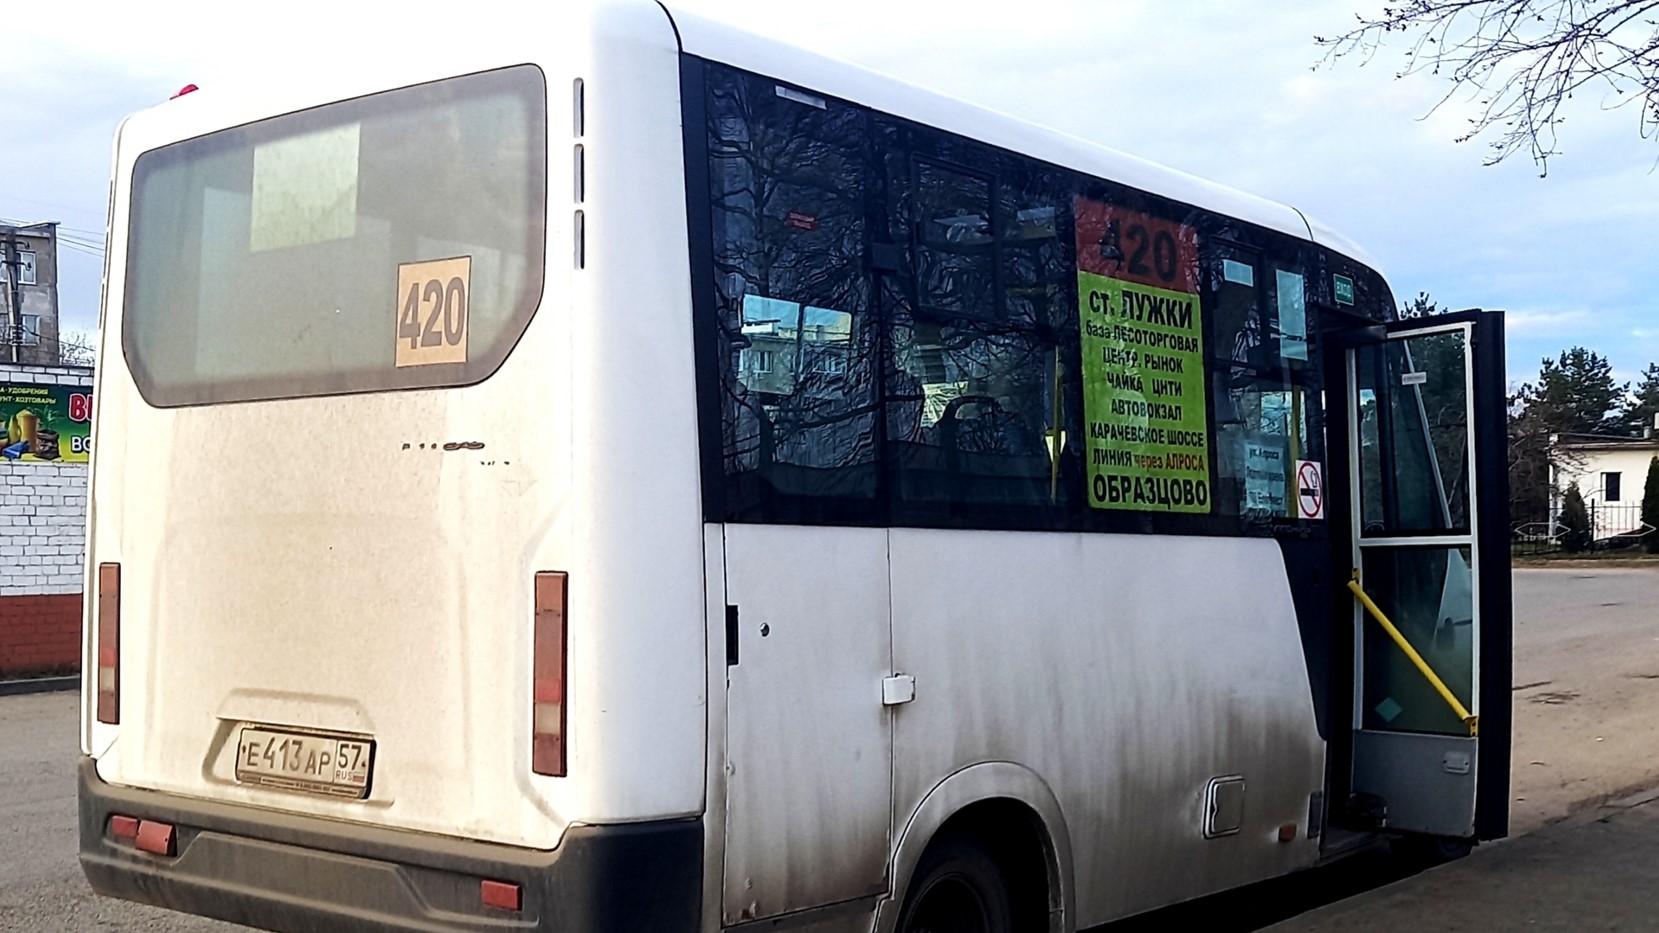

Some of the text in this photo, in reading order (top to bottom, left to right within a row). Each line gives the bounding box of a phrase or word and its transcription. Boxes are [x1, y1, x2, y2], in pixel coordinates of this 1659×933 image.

[1099, 219, 1178, 282] 420
[399, 276, 466, 350] 420
[1121, 290, 1192, 329] ЛУЖКИ
[1144, 354, 1183, 373] РЫНОК
[1106, 371, 1182, 397] ЧАЙКА ЦНТИ
[1111, 399, 1182, 420] АВТОВОКЗАЛ
[1090, 422, 1204, 447] КАРАЧЕВСКОЕ ШОССЕ
[1093, 448, 1132, 467] ЛИНИЯ
[1165, 453, 1205, 471] АЛРОСА
[1093, 474, 1208, 510] ОБРАЗЦОВО
[338, 743, 362, 771] 57
[335, 770, 353, 781] RUS
